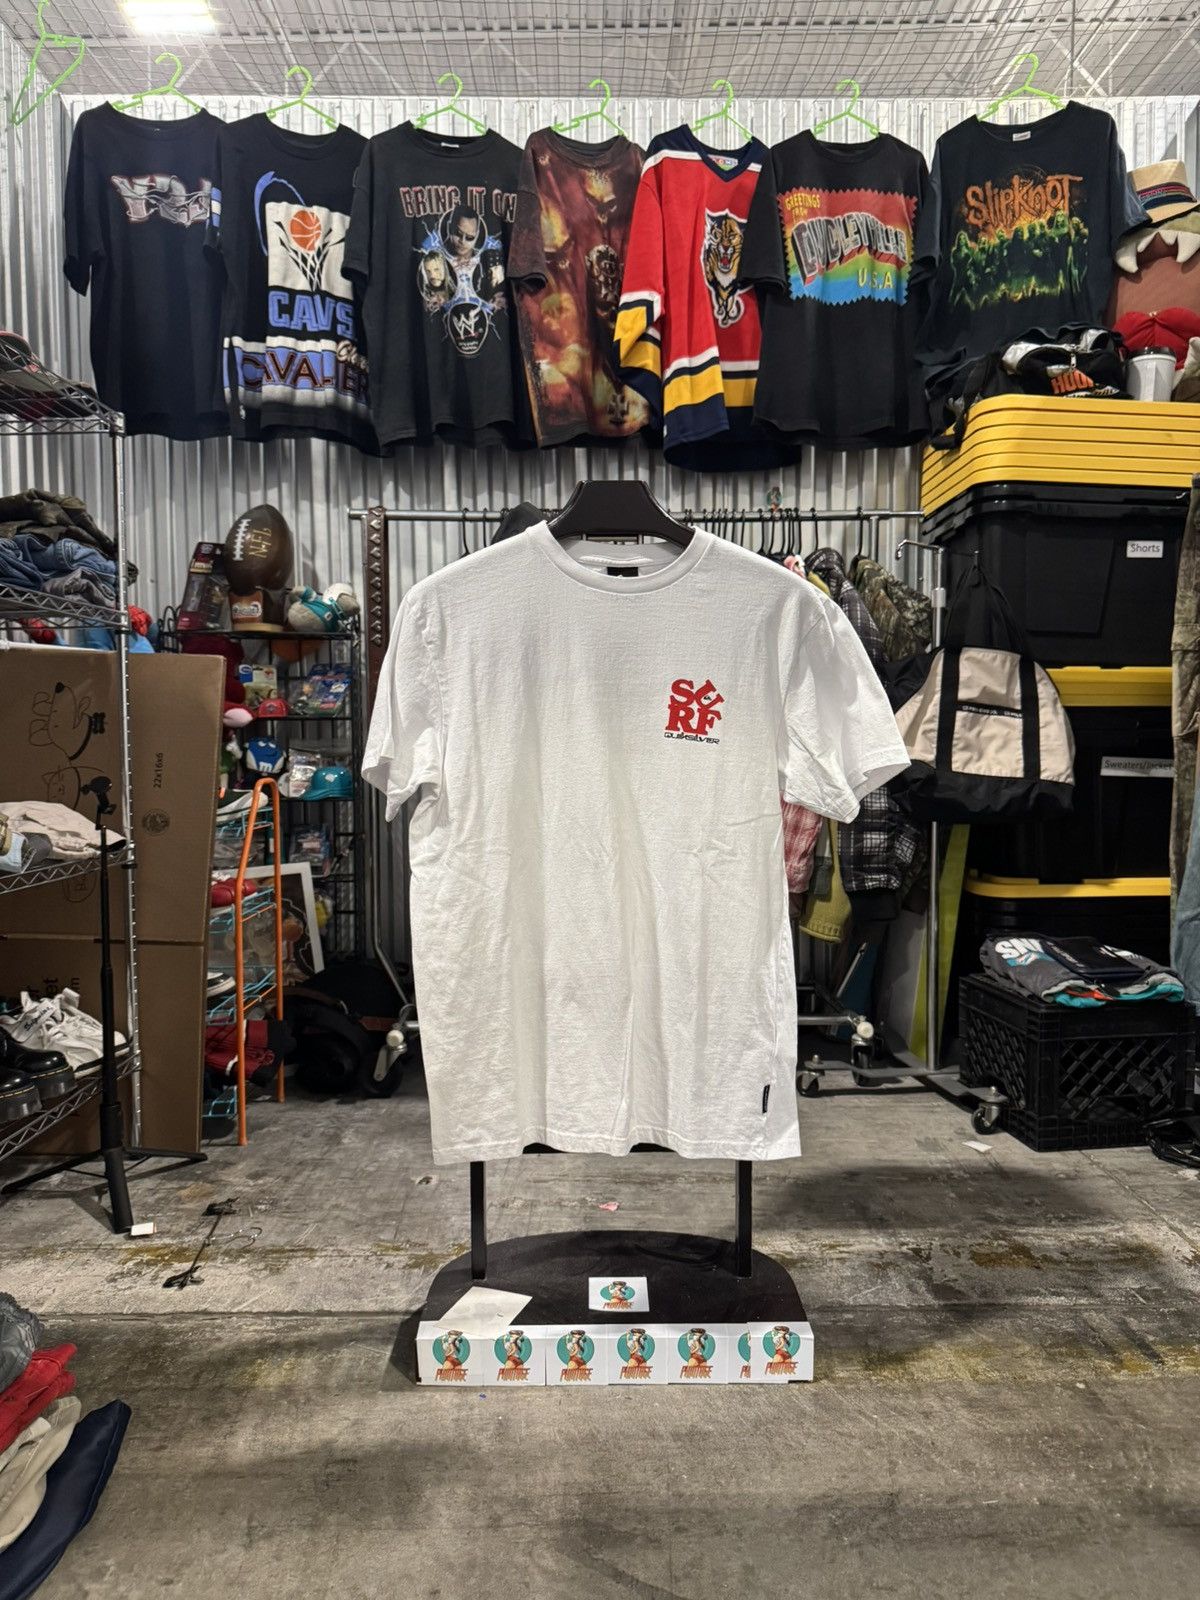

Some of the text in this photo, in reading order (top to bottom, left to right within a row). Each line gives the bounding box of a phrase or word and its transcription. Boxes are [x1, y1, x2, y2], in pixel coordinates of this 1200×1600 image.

[399, 184, 518, 223] BRING IT ON
[268, 290, 354, 340] CAVS
[1130, 543, 1161, 553] Shorts
